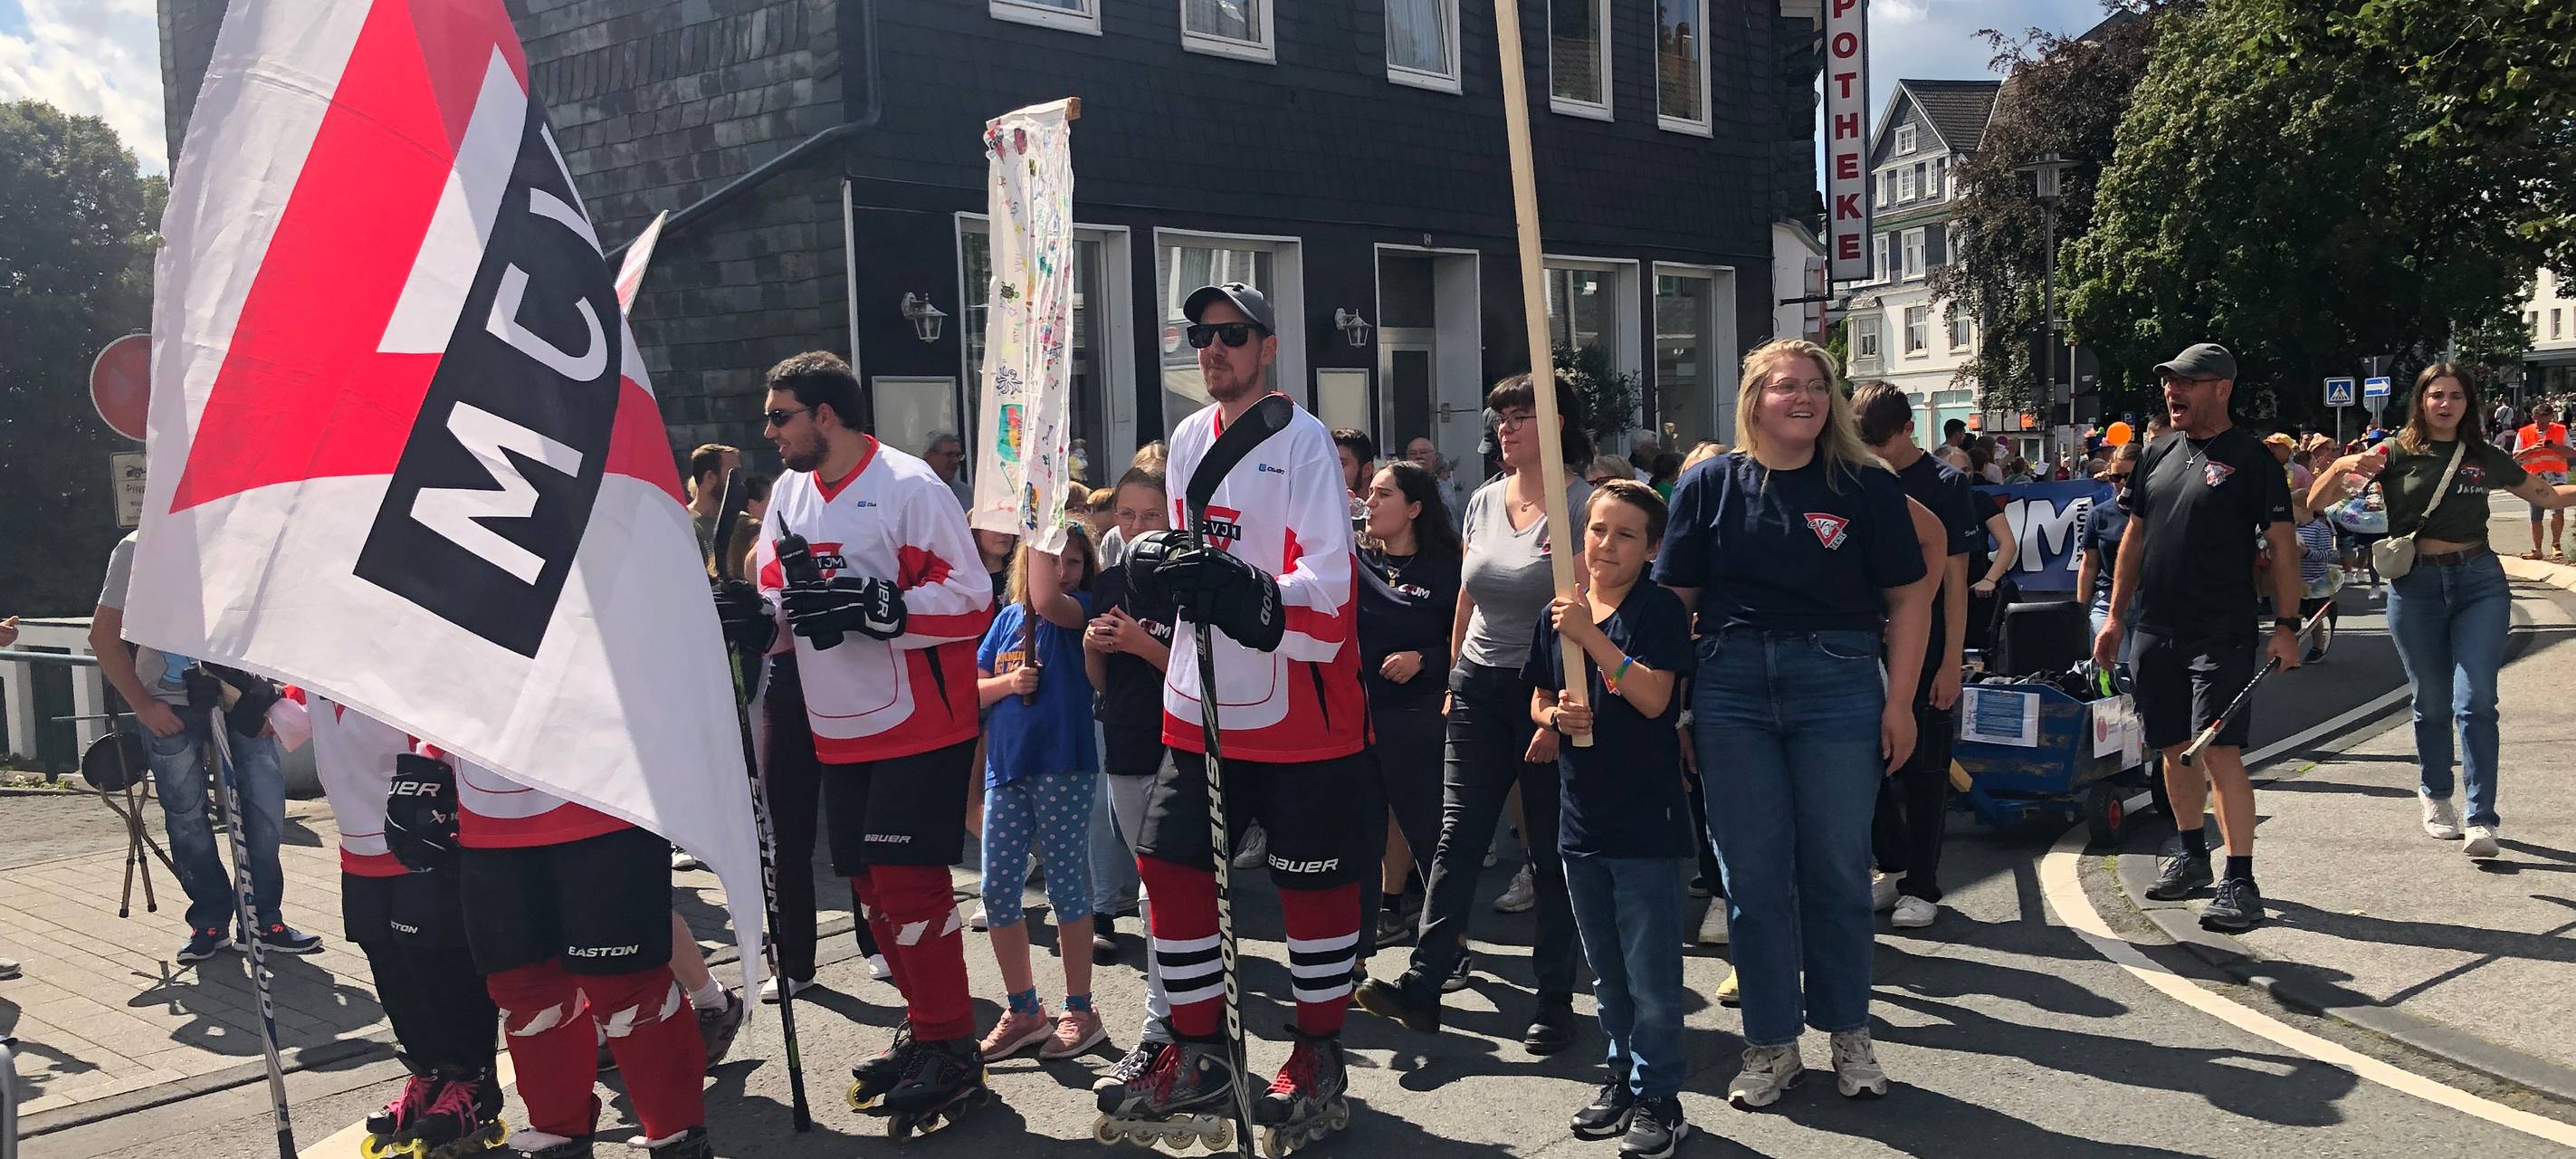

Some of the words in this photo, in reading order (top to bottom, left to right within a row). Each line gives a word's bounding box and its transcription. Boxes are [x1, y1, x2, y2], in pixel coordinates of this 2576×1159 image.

[1832, 0, 1863, 260] POTHEKE
[816, 554, 844, 569] VJM
[388, 781, 441, 797] UER
[1204, 752, 1241, 1042] SHER-WOOD
[568, 943, 639, 958] EASTON
